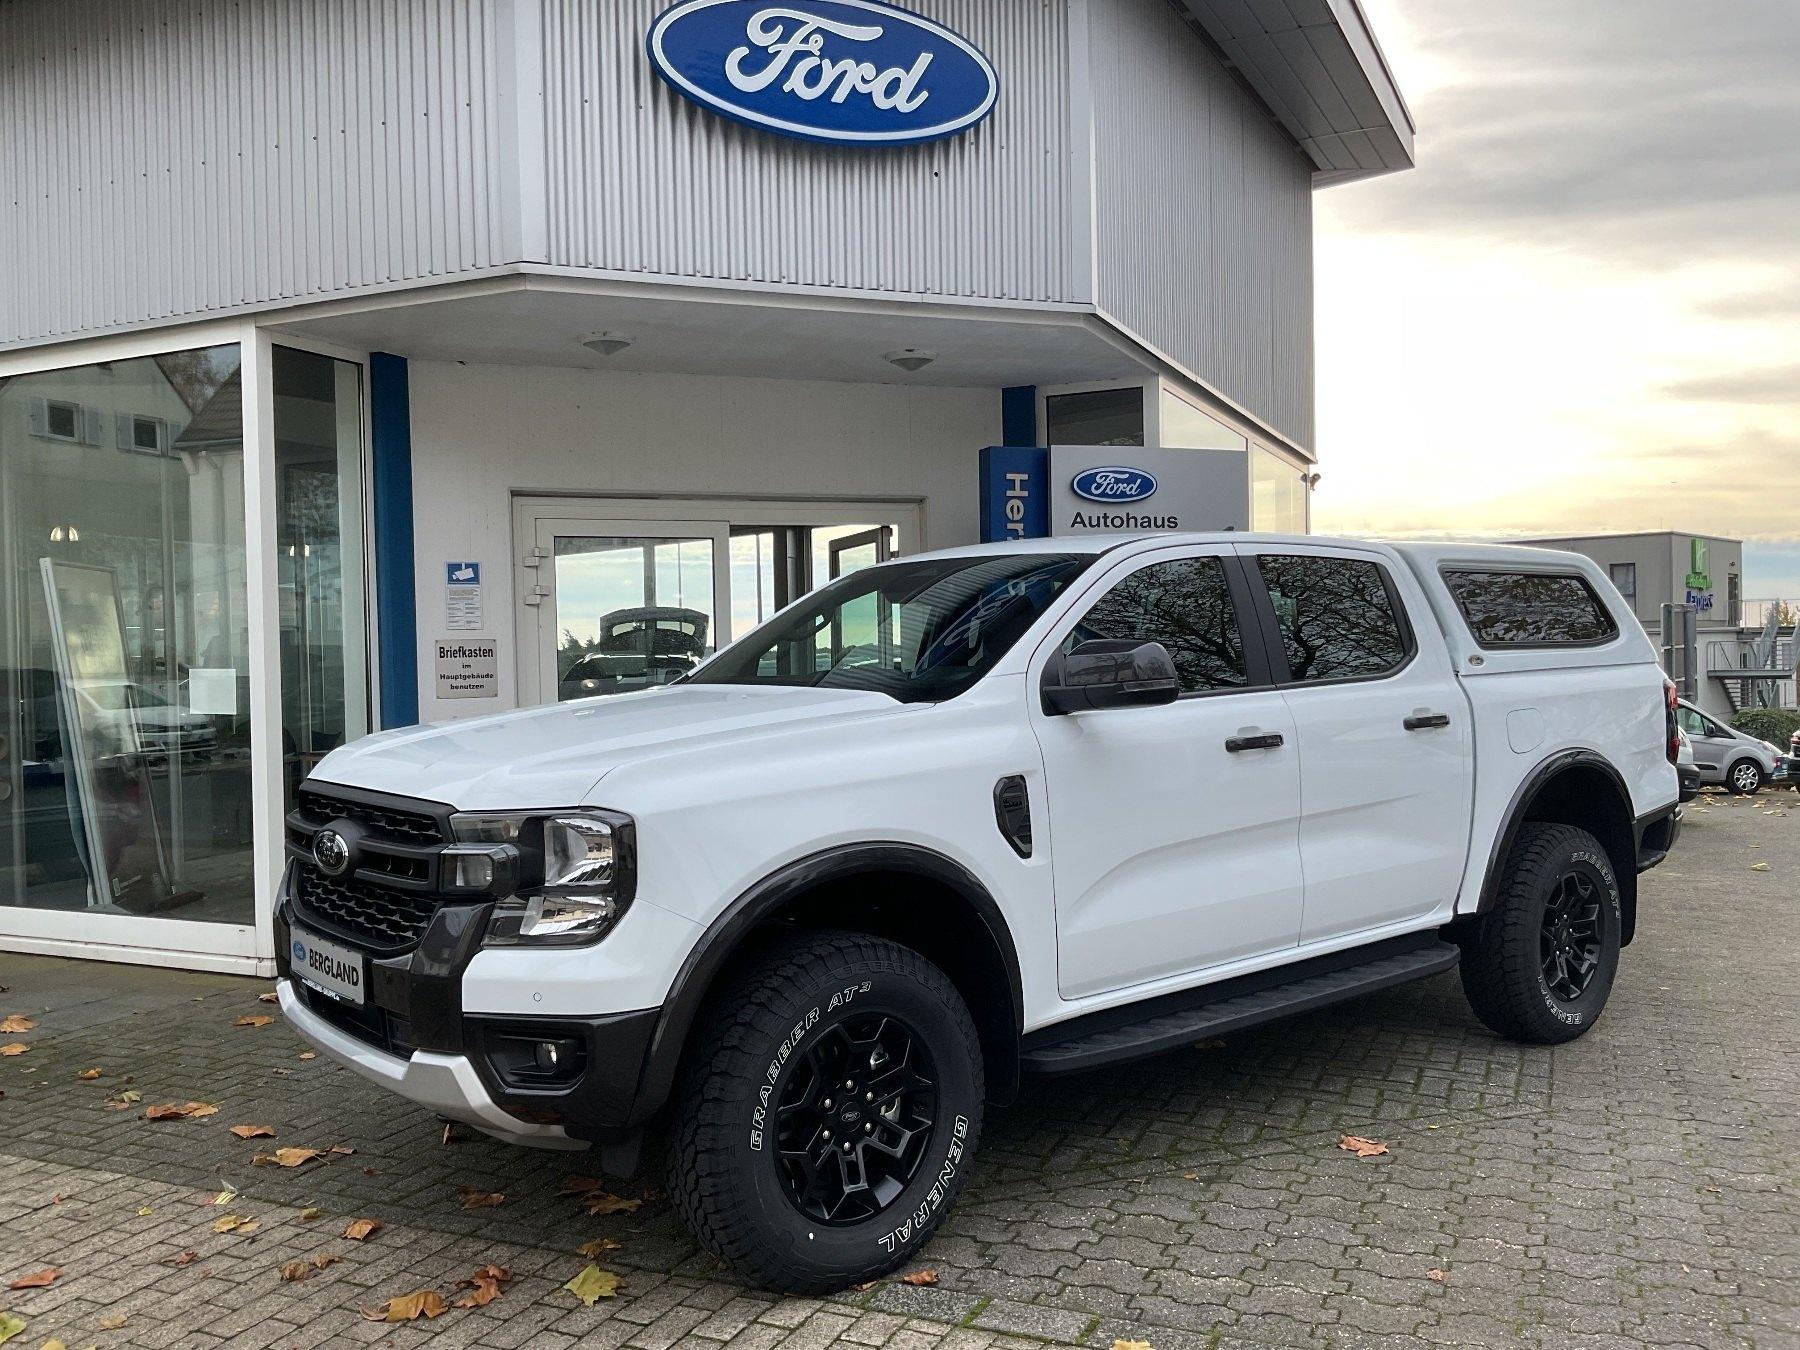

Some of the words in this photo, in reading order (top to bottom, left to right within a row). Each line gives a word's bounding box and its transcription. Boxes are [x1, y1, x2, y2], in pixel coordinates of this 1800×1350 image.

[725, 8, 933, 113] Ford
[1090, 472, 1142, 495] Ford
[1005, 473, 1028, 541] Her
[1070, 512, 1179, 529] Autohaus
[439, 646, 494, 659] Briefkasten
[439, 672, 495, 681] Hauptgebäude
[309, 948, 360, 987] BERGLAND
[750, 1007, 820, 1151] GRABBER
[878, 1115, 969, 1252] GENERAL
